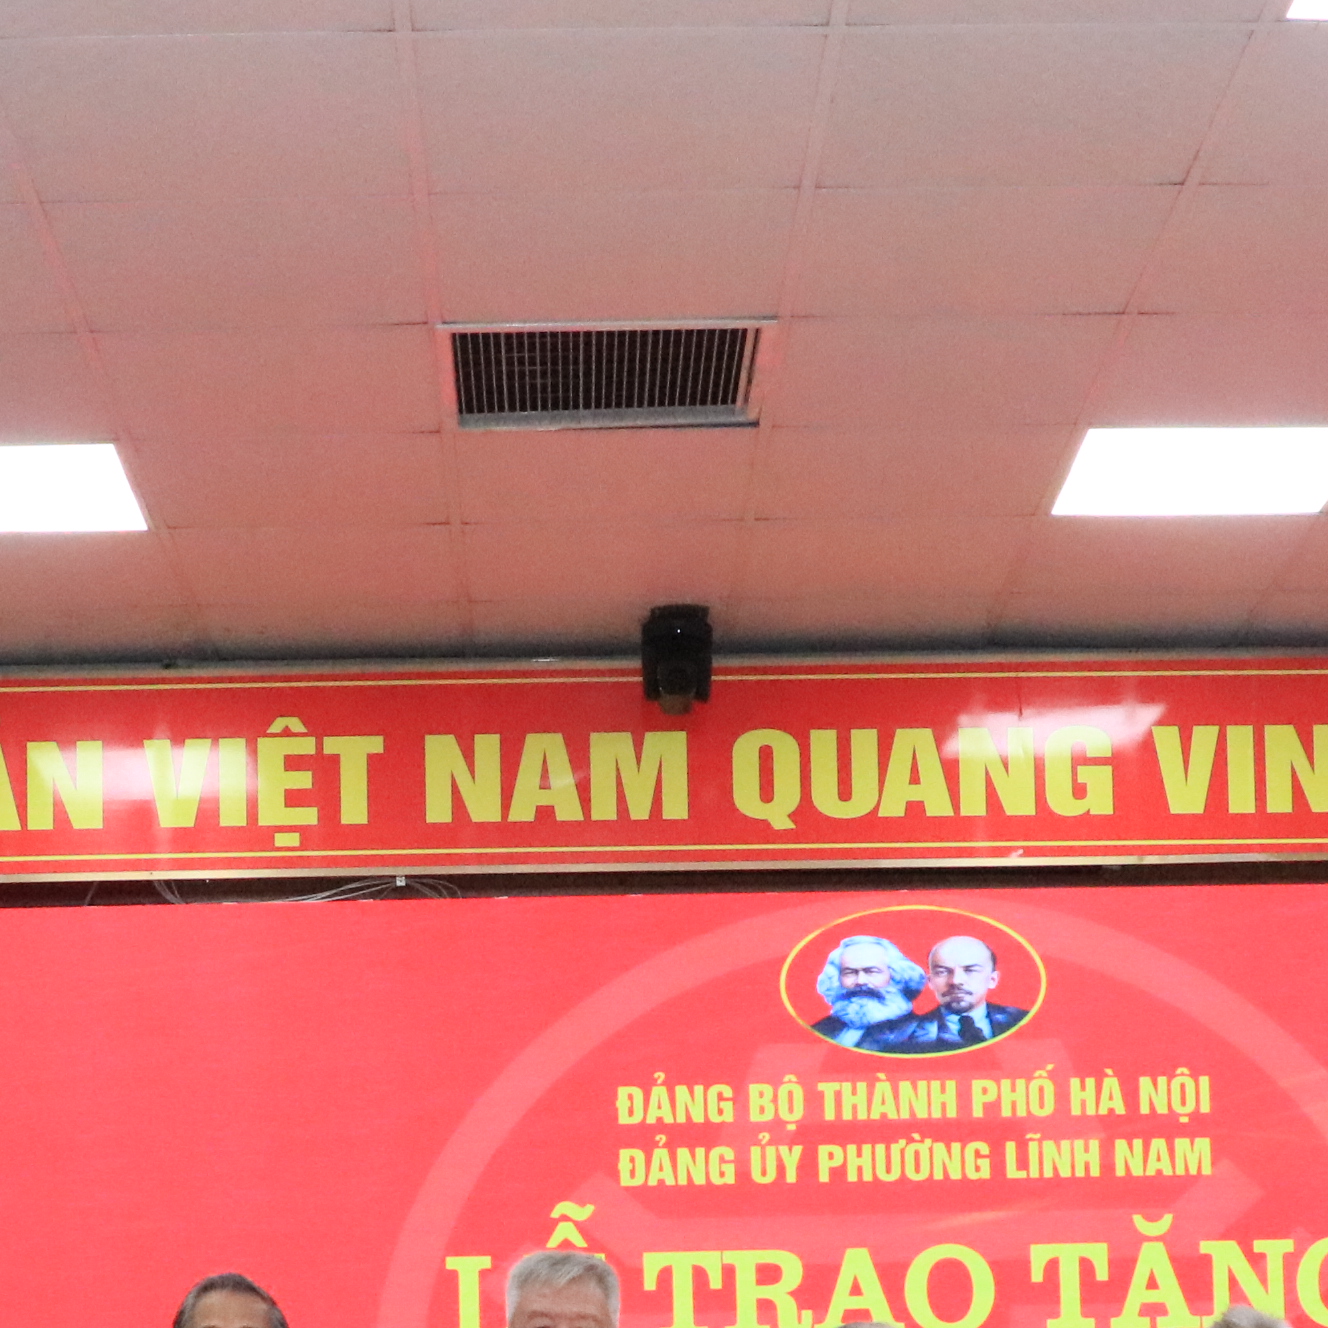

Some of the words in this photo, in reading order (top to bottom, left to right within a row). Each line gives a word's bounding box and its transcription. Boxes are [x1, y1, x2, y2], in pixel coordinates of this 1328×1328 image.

[143, 716, 384, 847] VIỆT
[425, 731, 689, 824] NAM
[732, 725, 1114, 830] QUANG
[616, 1071, 734, 1125] ĐẢNG
[749, 1074, 805, 1130] BỘ
[818, 1073, 958, 1121] THÀNH
[972, 1064, 1056, 1118] PHỐ
[1070, 1067, 1126, 1116] HÀ
[1139, 1067, 1212, 1122] NỘI
[617, 1134, 735, 1187] ĐẢNG
[750, 1132, 803, 1184] ỦY
[818, 1132, 991, 1183] PHƯỜNG
[1005, 1132, 1101, 1178] LĨNH
[1113, 1137, 1213, 1176] NAM
